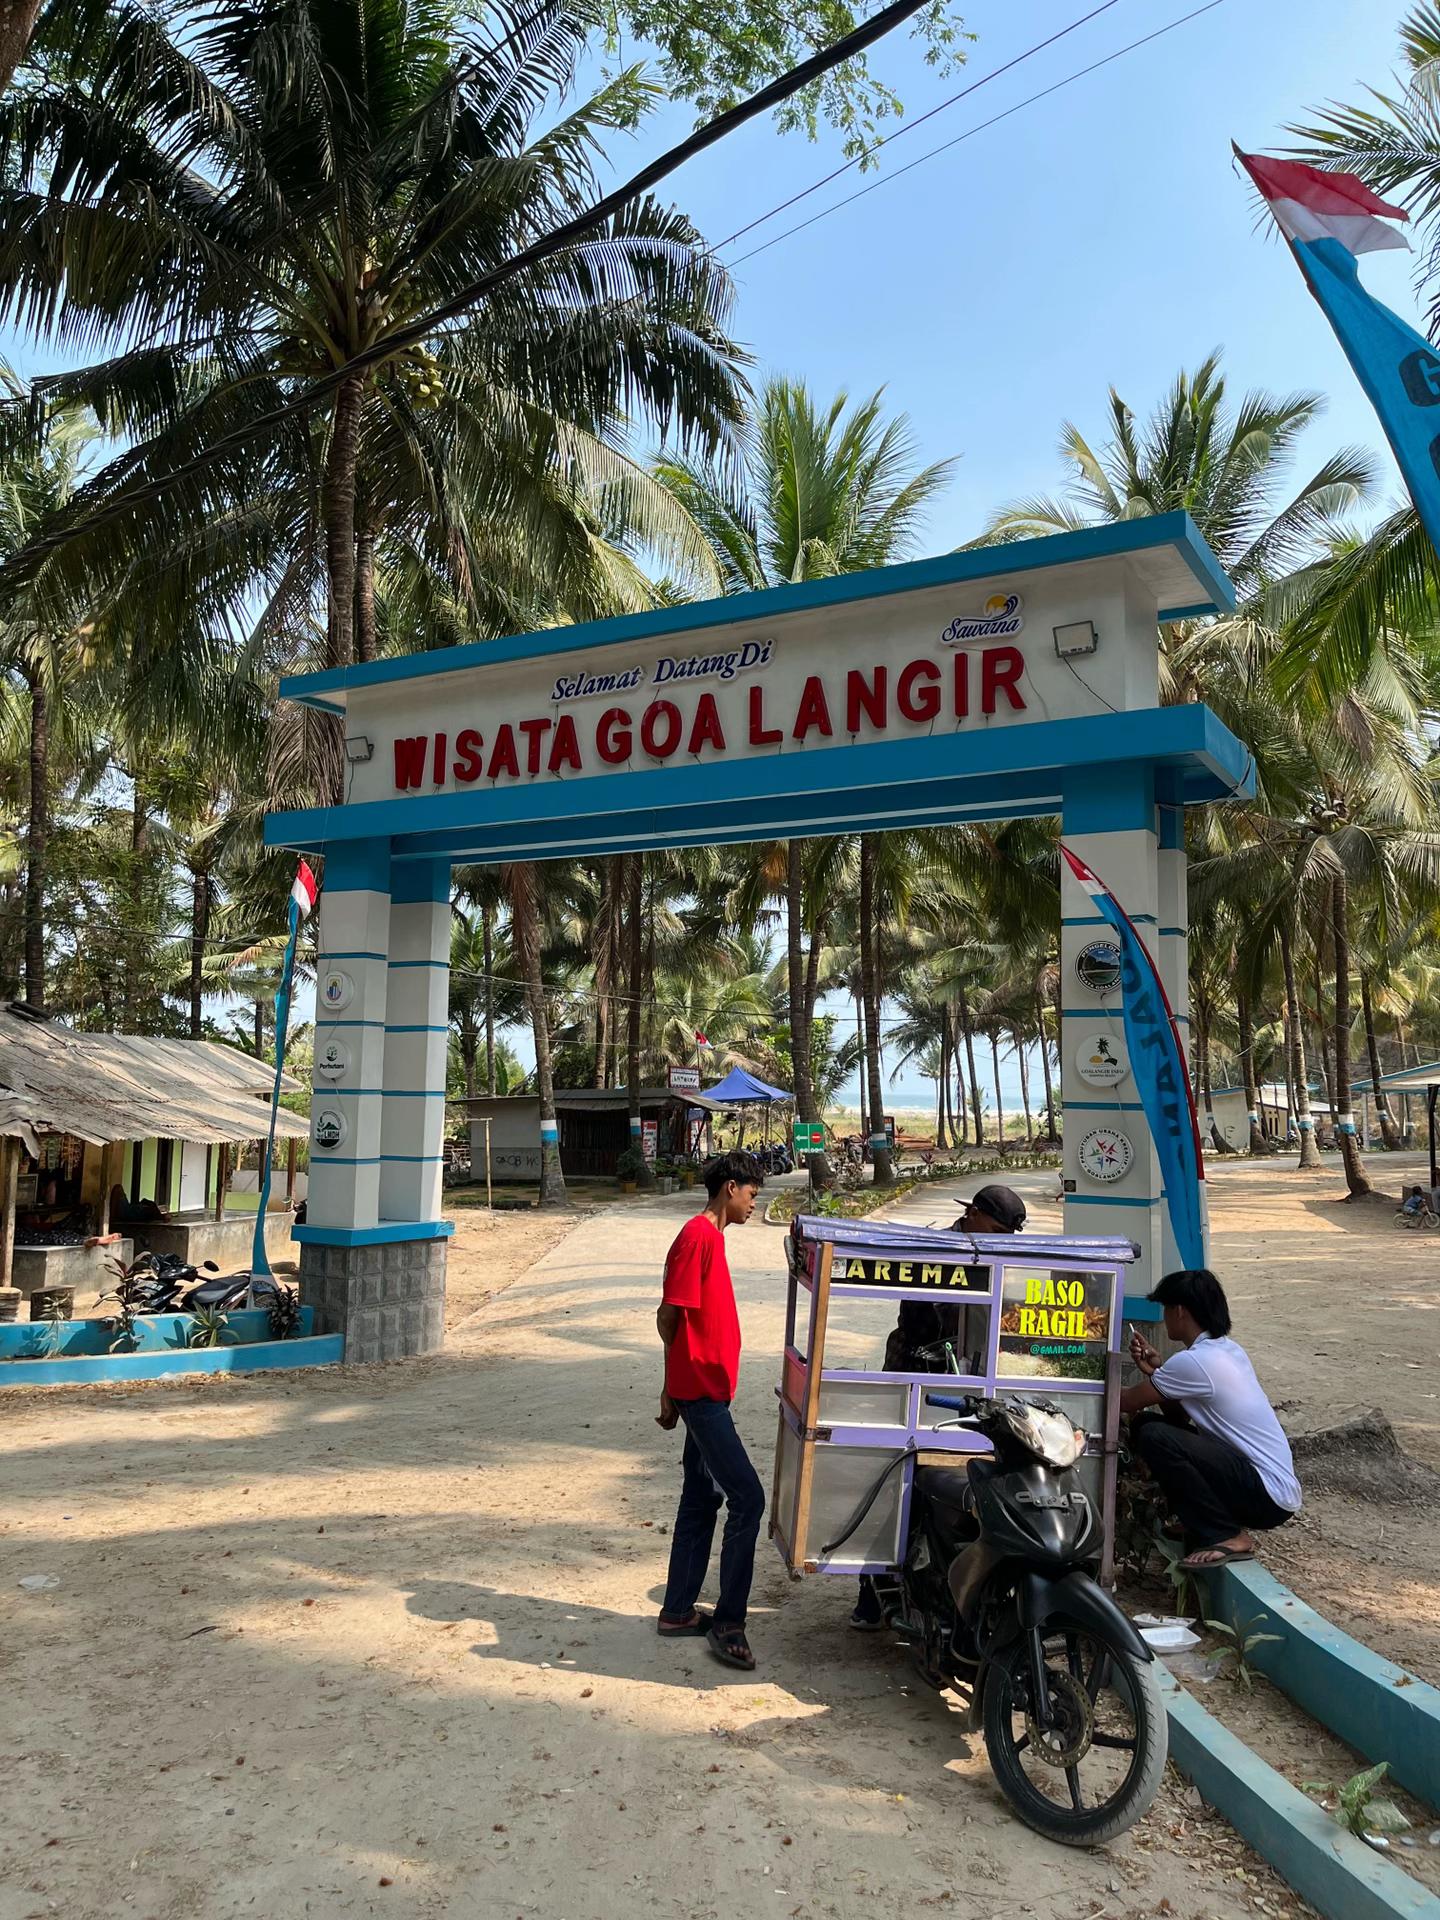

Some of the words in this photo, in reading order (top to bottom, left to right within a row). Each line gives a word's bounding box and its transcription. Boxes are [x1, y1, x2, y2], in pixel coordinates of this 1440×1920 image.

[942, 617, 1020, 641] Sawarna
[551, 667, 642, 700] Selamat
[394, 714, 582, 790] WISATA
[596, 693, 726, 764] GOA
[749, 646, 1027, 746] LANGIR
[846, 1259, 969, 1287] AREMA
[1024, 1278, 1084, 1307] BASO
[1019, 1308, 1088, 1338] RAGIL
[1030, 1343, 1086, 1355] @GMAIL.COM
